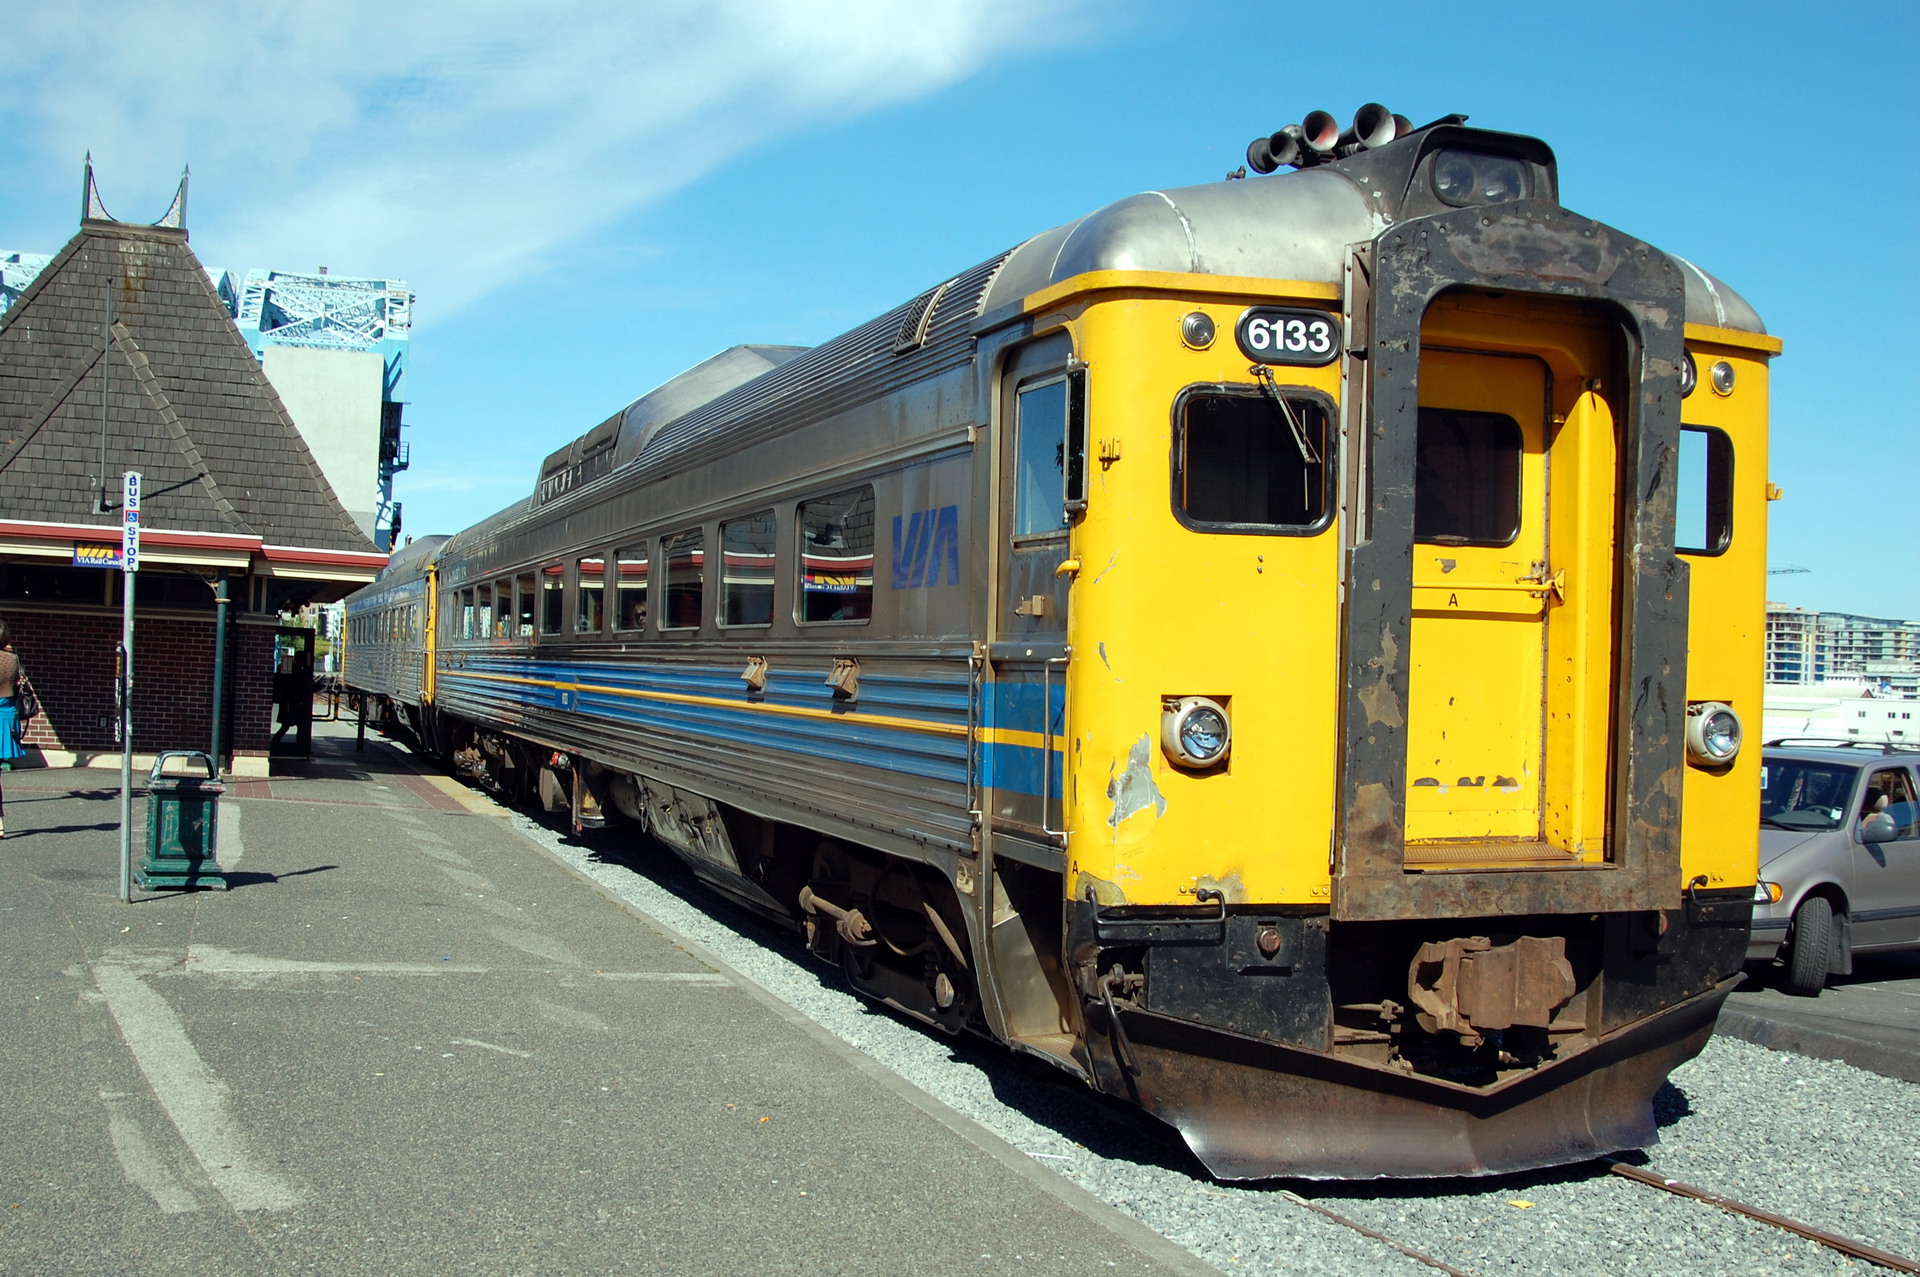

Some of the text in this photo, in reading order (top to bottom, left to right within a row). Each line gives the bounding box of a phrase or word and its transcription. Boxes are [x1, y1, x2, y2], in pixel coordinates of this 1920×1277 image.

[1248, 318, 1331, 353] 6133
[127, 477, 137, 566] BUS STOP
[77, 544, 114, 559] VIA
[891, 504, 959, 590] VIA
[77, 556, 123, 566] VIA Rail Canad
[1448, 593, 1459, 607] A
[1072, 860, 1079, 875] A
